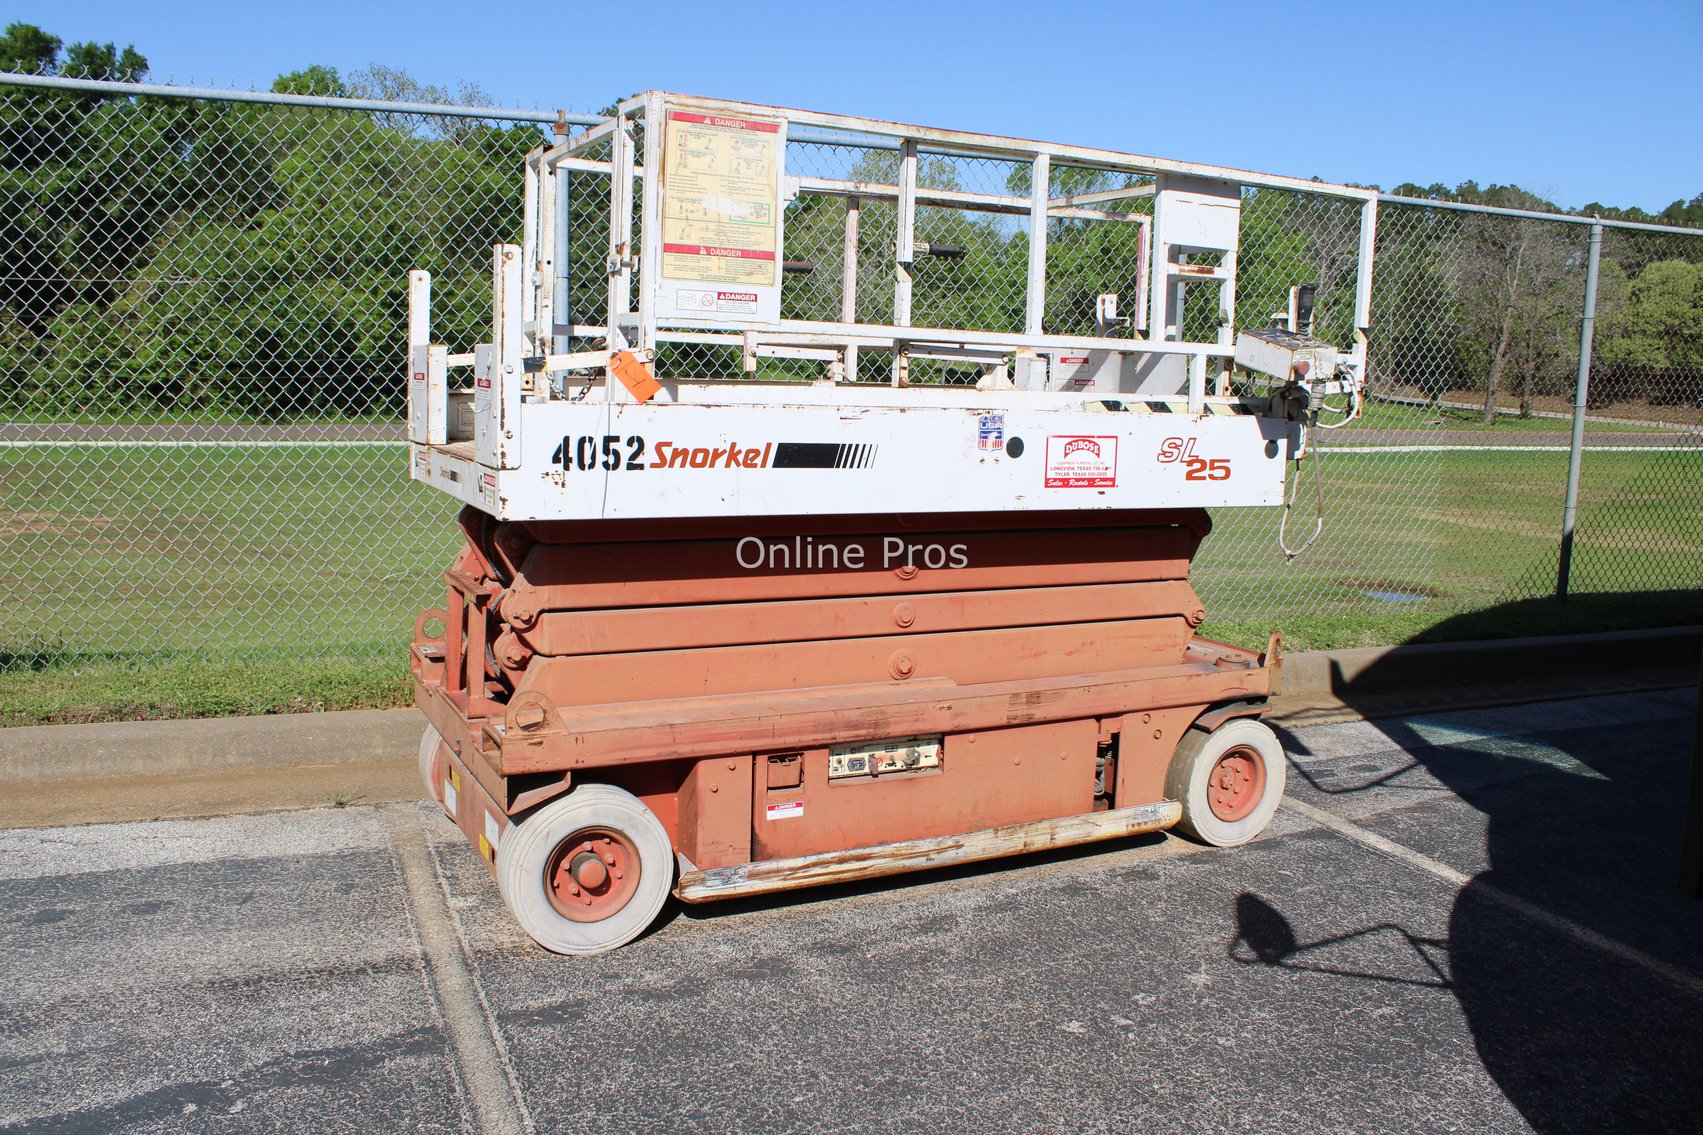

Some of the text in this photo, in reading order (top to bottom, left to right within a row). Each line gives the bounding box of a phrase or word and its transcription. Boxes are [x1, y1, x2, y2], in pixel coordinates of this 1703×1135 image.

[714, 118, 746, 128] DANGER
[710, 248, 742, 257] DANGER
[724, 293, 756, 301] DANGER
[551, 435, 646, 471] 4052
[1066, 441, 1099, 453] DUBOSE
[1156, 437, 1200, 463] SL
[649, 441, 773, 469] Snorkel
[1185, 458, 1231, 481] 25
[1068, 478, 1089, 486] Rentals
[1094, 478, 1114, 486] Service
